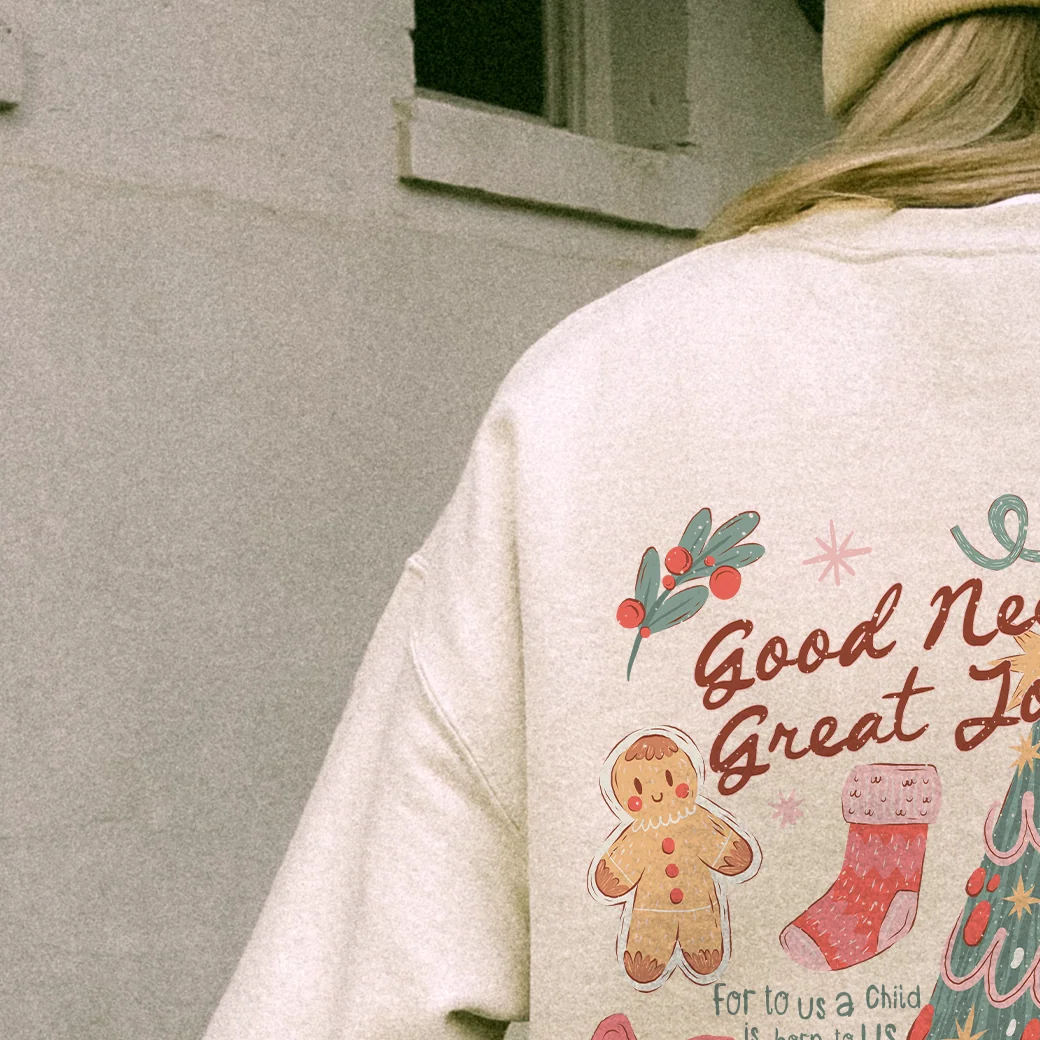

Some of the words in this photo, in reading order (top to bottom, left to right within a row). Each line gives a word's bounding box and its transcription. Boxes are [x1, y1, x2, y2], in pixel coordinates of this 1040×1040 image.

[694, 583, 903, 711] Good
[709, 666, 934, 796] Great
[714, 985, 754, 1015] For
[766, 988, 787, 1015] to
[798, 998, 825, 1019] us
[837, 993, 853, 1016] a
[866, 985, 920, 1008] Child
